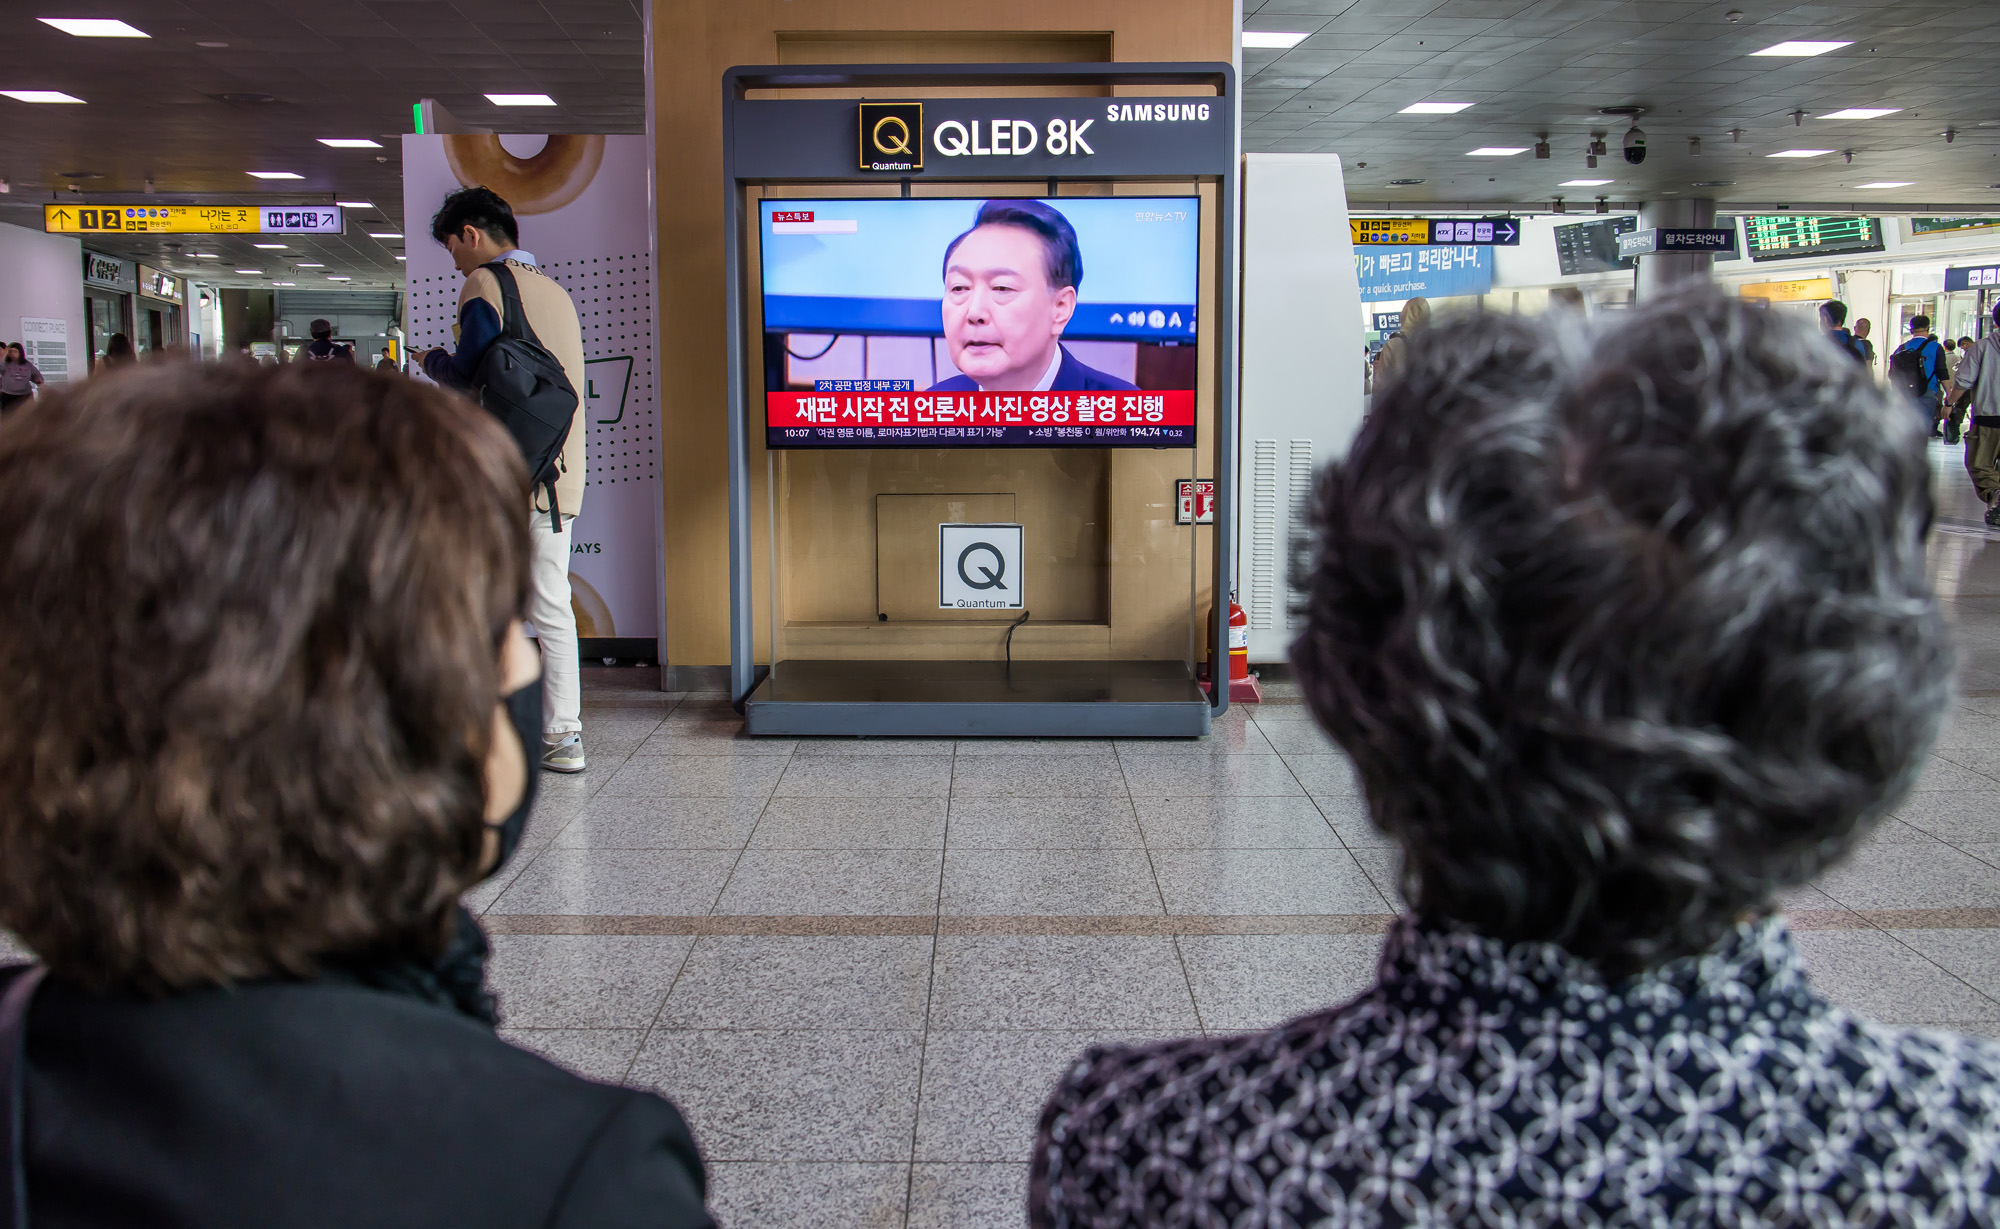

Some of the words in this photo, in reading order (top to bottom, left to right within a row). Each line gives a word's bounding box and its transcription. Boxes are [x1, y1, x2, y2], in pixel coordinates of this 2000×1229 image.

[1107, 104, 1209, 121] SAMSUNG
[873, 116, 912, 155] Q
[933, 119, 1038, 156] QLED
[1046, 119, 1095, 156] 8K
[872, 162, 911, 171] Quantum
[84, 212, 94, 227] 1
[106, 212, 118, 227] 2
[200, 209, 231, 222] 나가는
[237, 209, 247, 222] 곳
[777, 212, 810, 221] 뉴스특보
[210, 222, 223, 230] Exit
[1623, 235, 1652, 250] 열차도착안내
[1665, 233, 1726, 245] 열차도착안내
[1379, 252, 1412, 276] 빠르고
[1418, 246, 1480, 273] 편리합니다.
[1373, 283, 1392, 296] quick
[1394, 281, 1427, 294] purchase.
[819, 381, 833, 391] 2차
[835, 381, 852, 391] 공판
[854, 381, 871, 391] 법정
[873, 381, 891, 391] 내부
[892, 381, 910, 391] 공개
[796, 396, 838, 423] 재판
[842, 396, 885, 423] 시작
[888, 396, 909, 423] 전
[914, 396, 977, 423] 언론사
[980, 396, 1072, 423] 사진·영상
[1075, 396, 1117, 423] 촬영
[1122, 396, 1164, 423] 진행
[784, 429, 809, 437] 10:07
[836, 428, 854, 438] 영문
[856, 428, 876, 439] 이름,
[877, 428, 937, 438] 로마자표기법과
[939, 428, 965, 438] 다르게
[966, 428, 984, 438] 표기
[1035, 428, 1053, 438] 소방
[1130, 428, 1160, 437] 194.74
[957, 541, 1008, 590] Q
[957, 599, 1006, 608] Quantum
